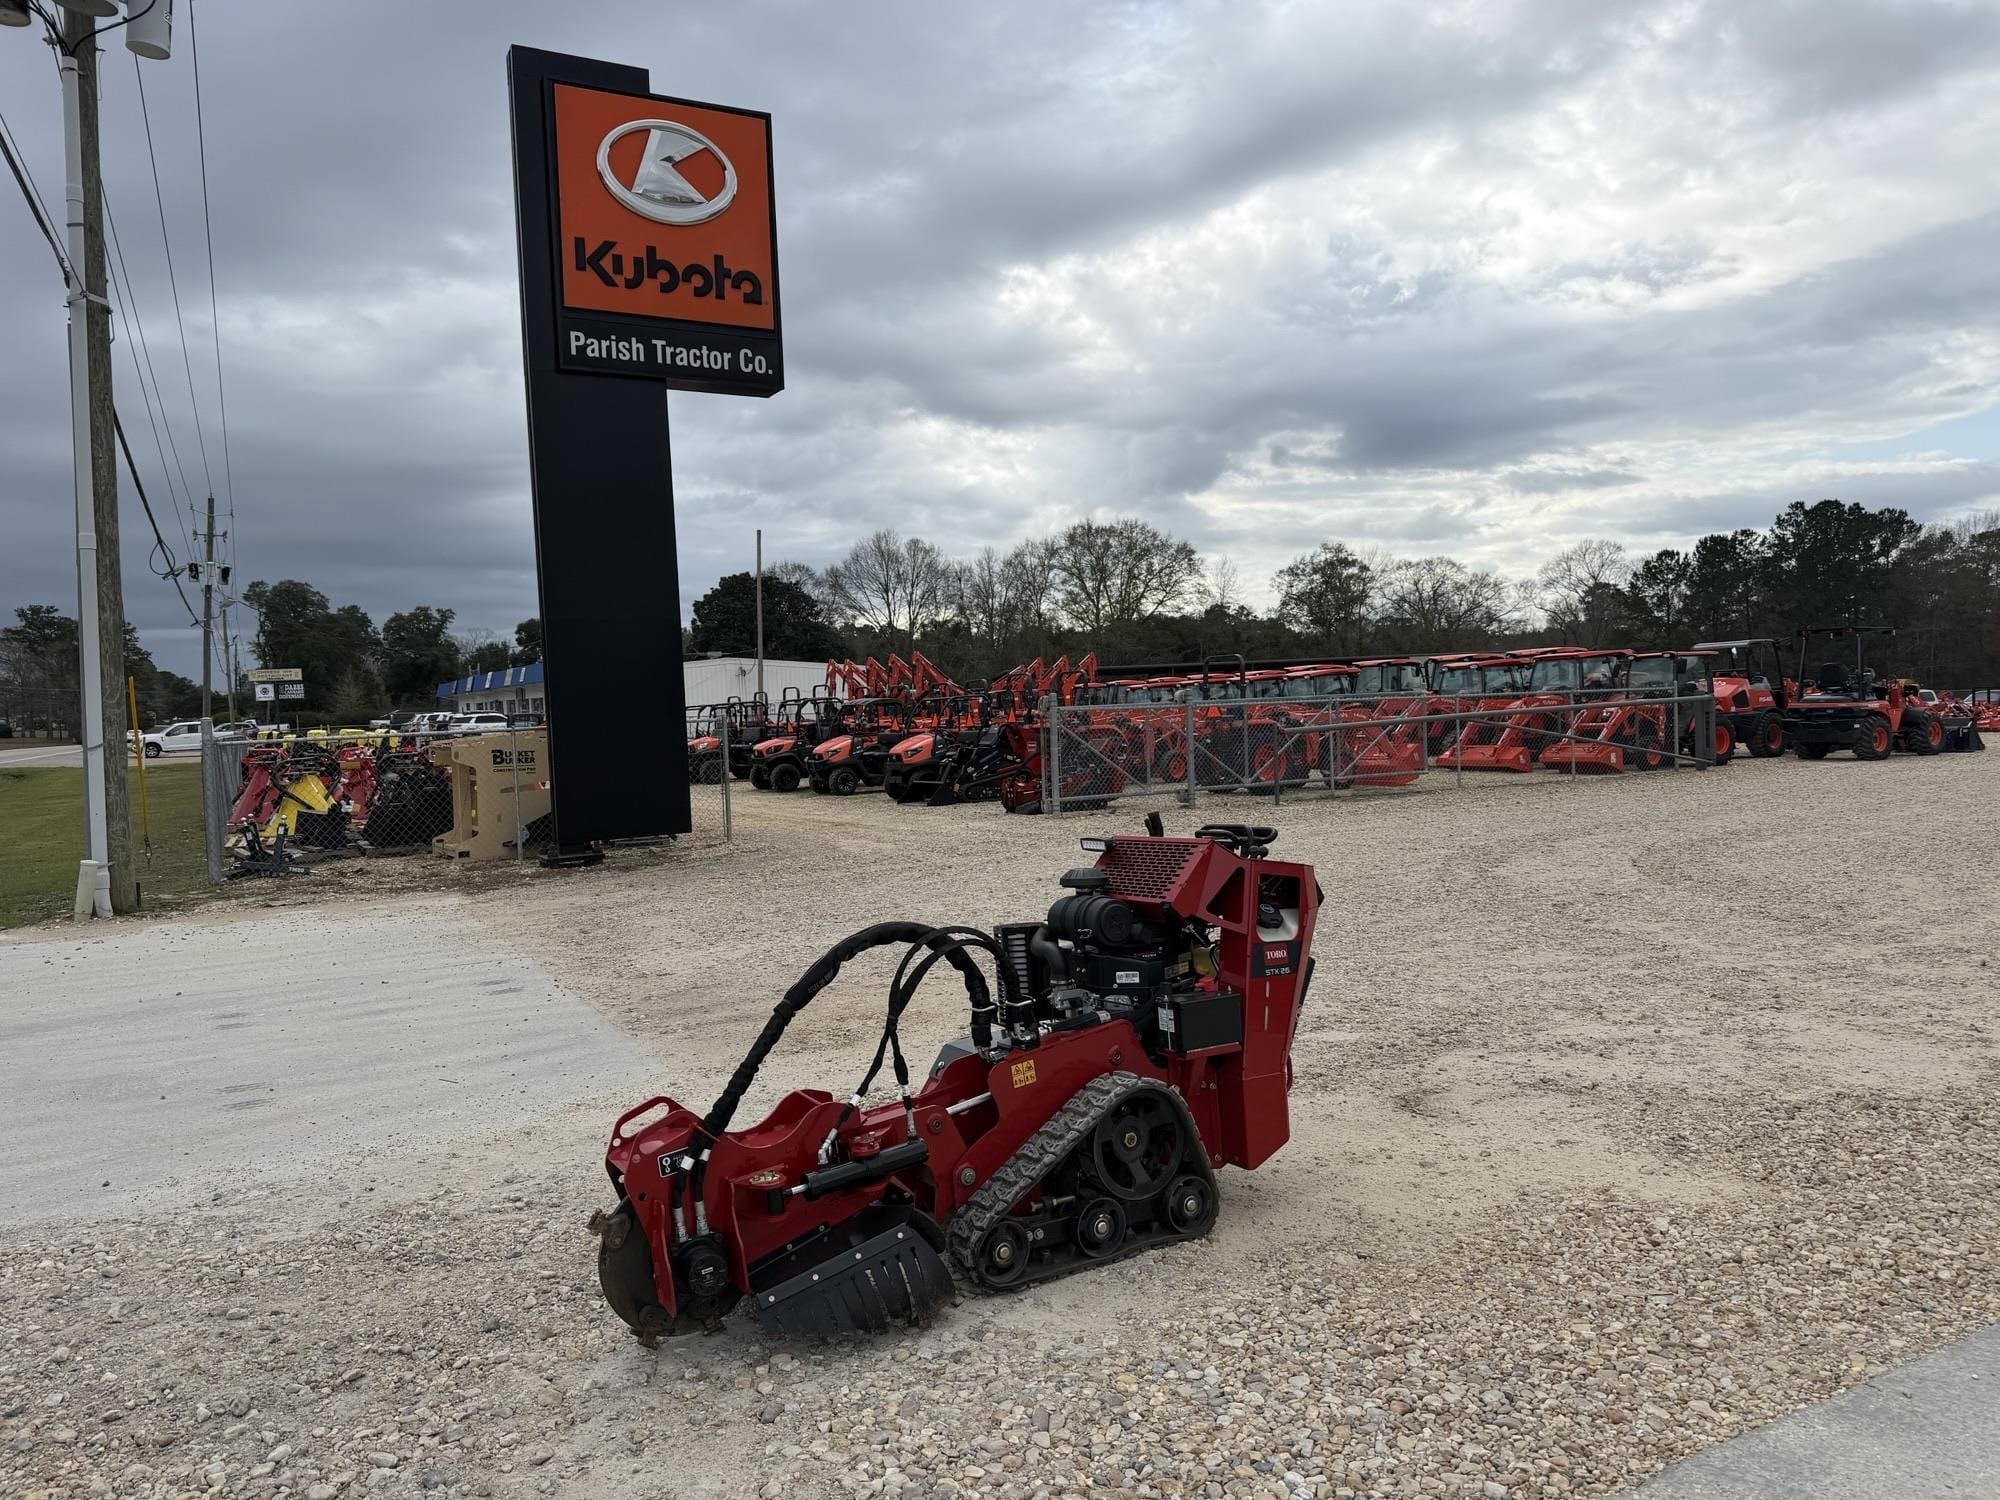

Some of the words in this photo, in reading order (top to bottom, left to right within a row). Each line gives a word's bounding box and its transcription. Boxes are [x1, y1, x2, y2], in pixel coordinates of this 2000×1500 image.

[574, 237, 764, 306] Kubota
[569, 331, 645, 362] Parish
[652, 340, 732, 371] Tractor
[739, 348, 774, 375] Co.
[1265, 949, 1287, 960] TORO
[1265, 967, 1280, 976] STX
[1280, 966, 1291, 975] 26
